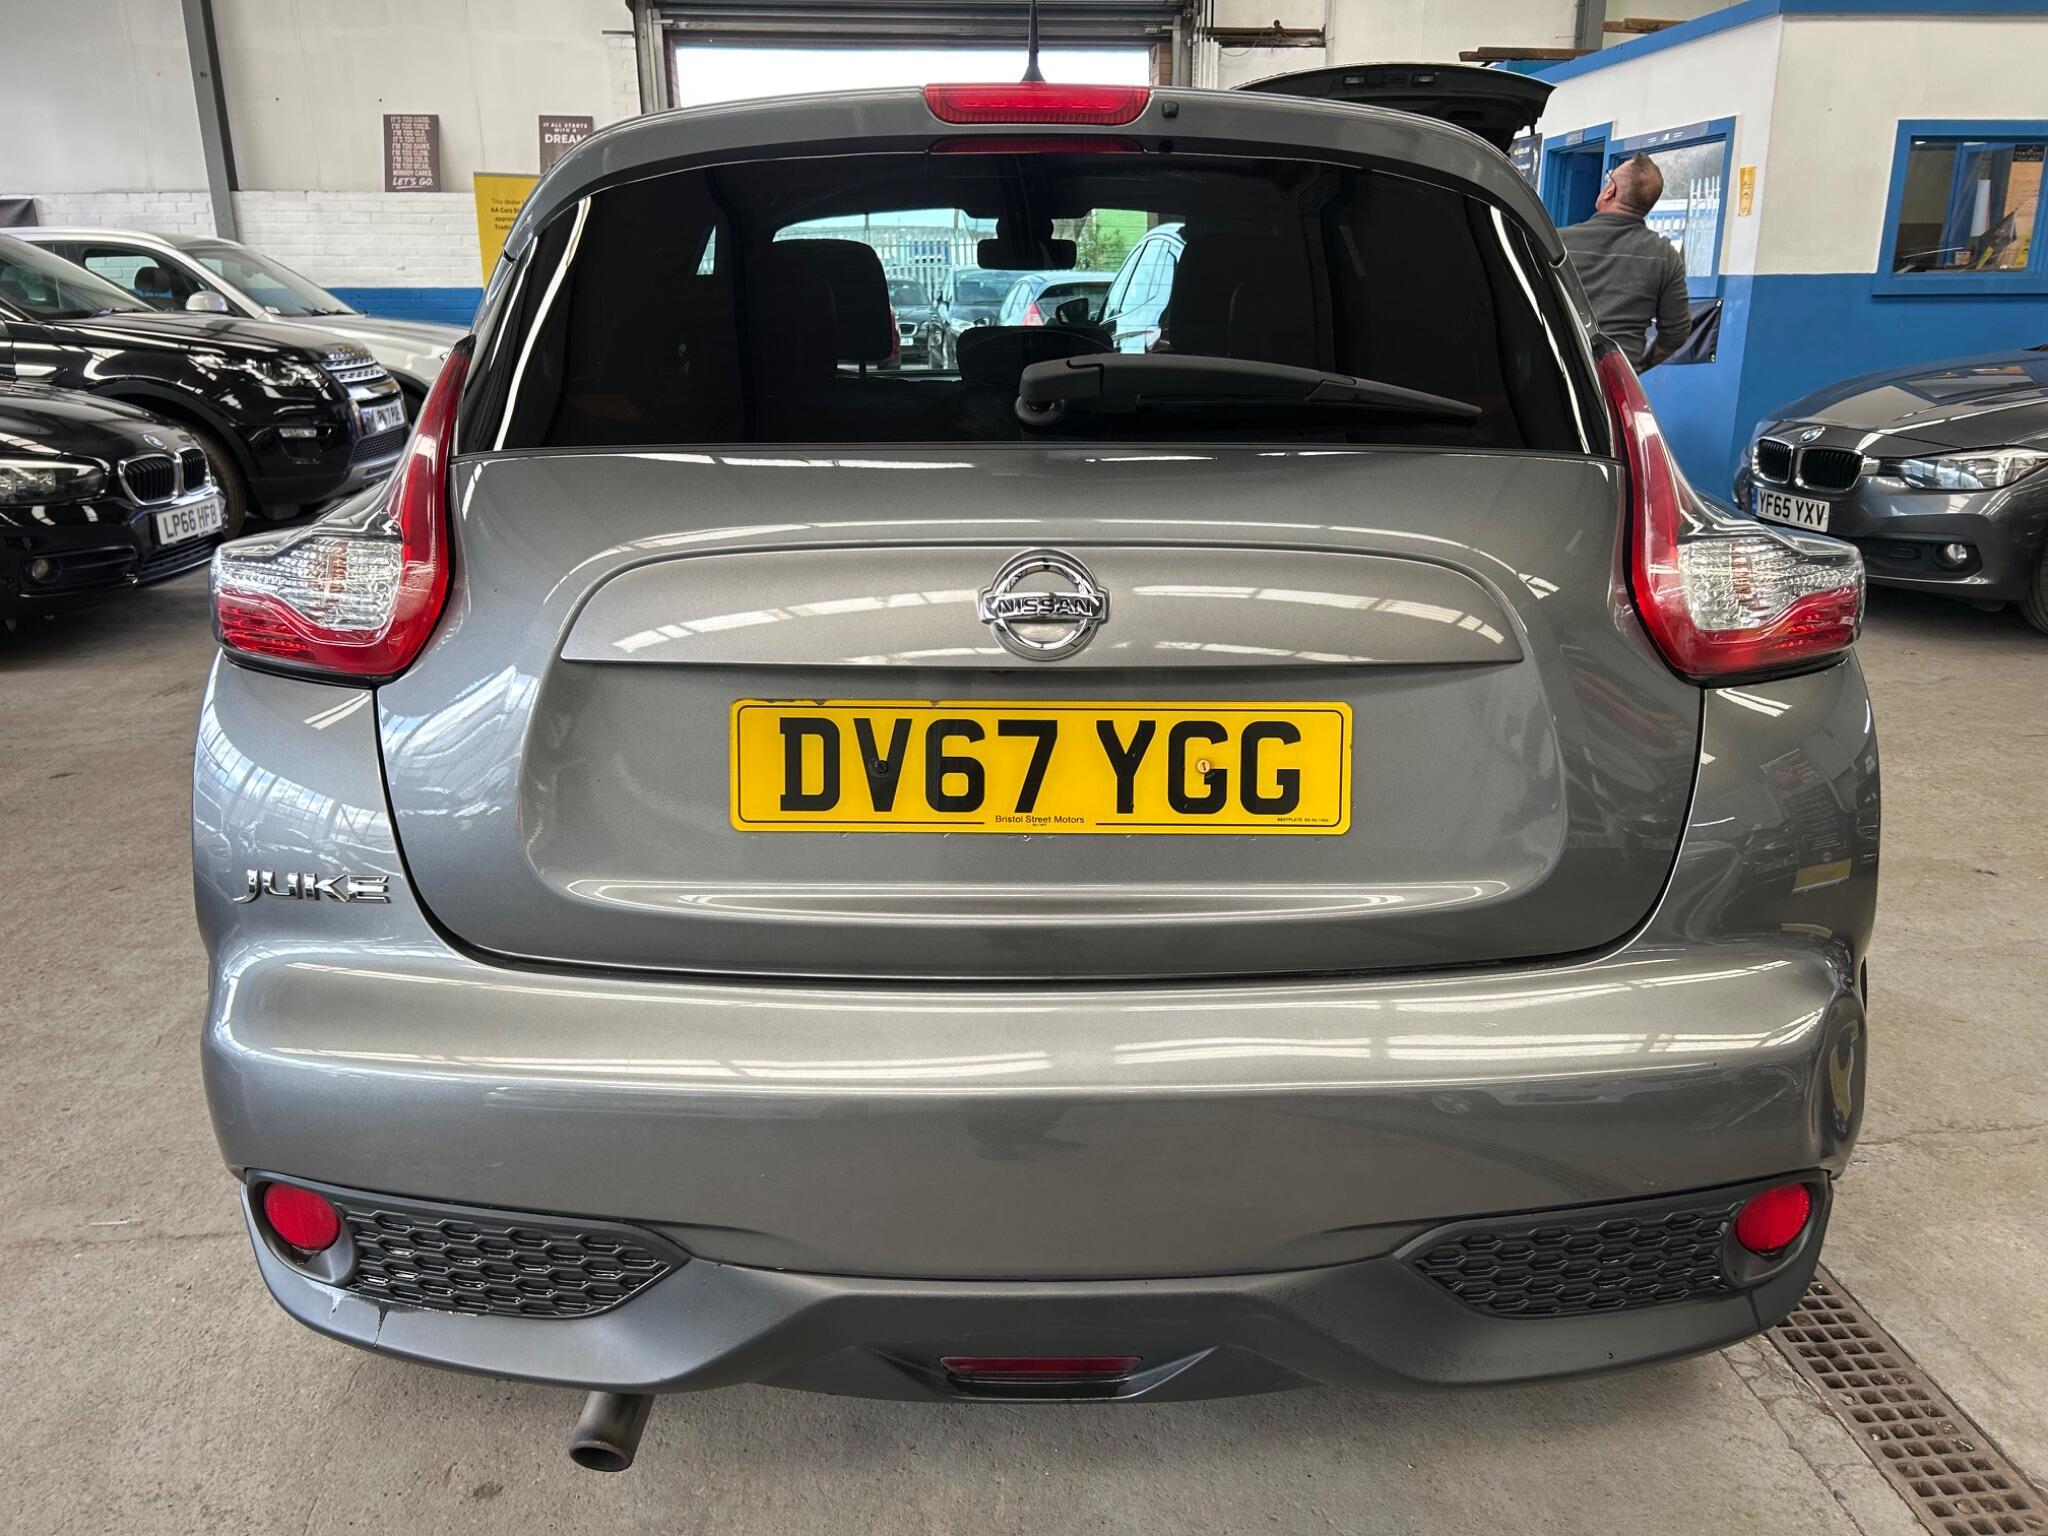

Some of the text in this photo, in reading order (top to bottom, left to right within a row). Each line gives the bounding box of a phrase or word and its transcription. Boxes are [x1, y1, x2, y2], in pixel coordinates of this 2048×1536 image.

[393, 177, 416, 186] LET'S
[163, 504, 218, 539] LP66 HFB
[1760, 491, 1826, 526] YF65 YXV
[998, 597, 1094, 617] NISSAN
[779, 716, 1302, 815] DV67 YGG
[995, 815, 1085, 824] Bristol Street Motors
[232, 869, 392, 904] JUKE
